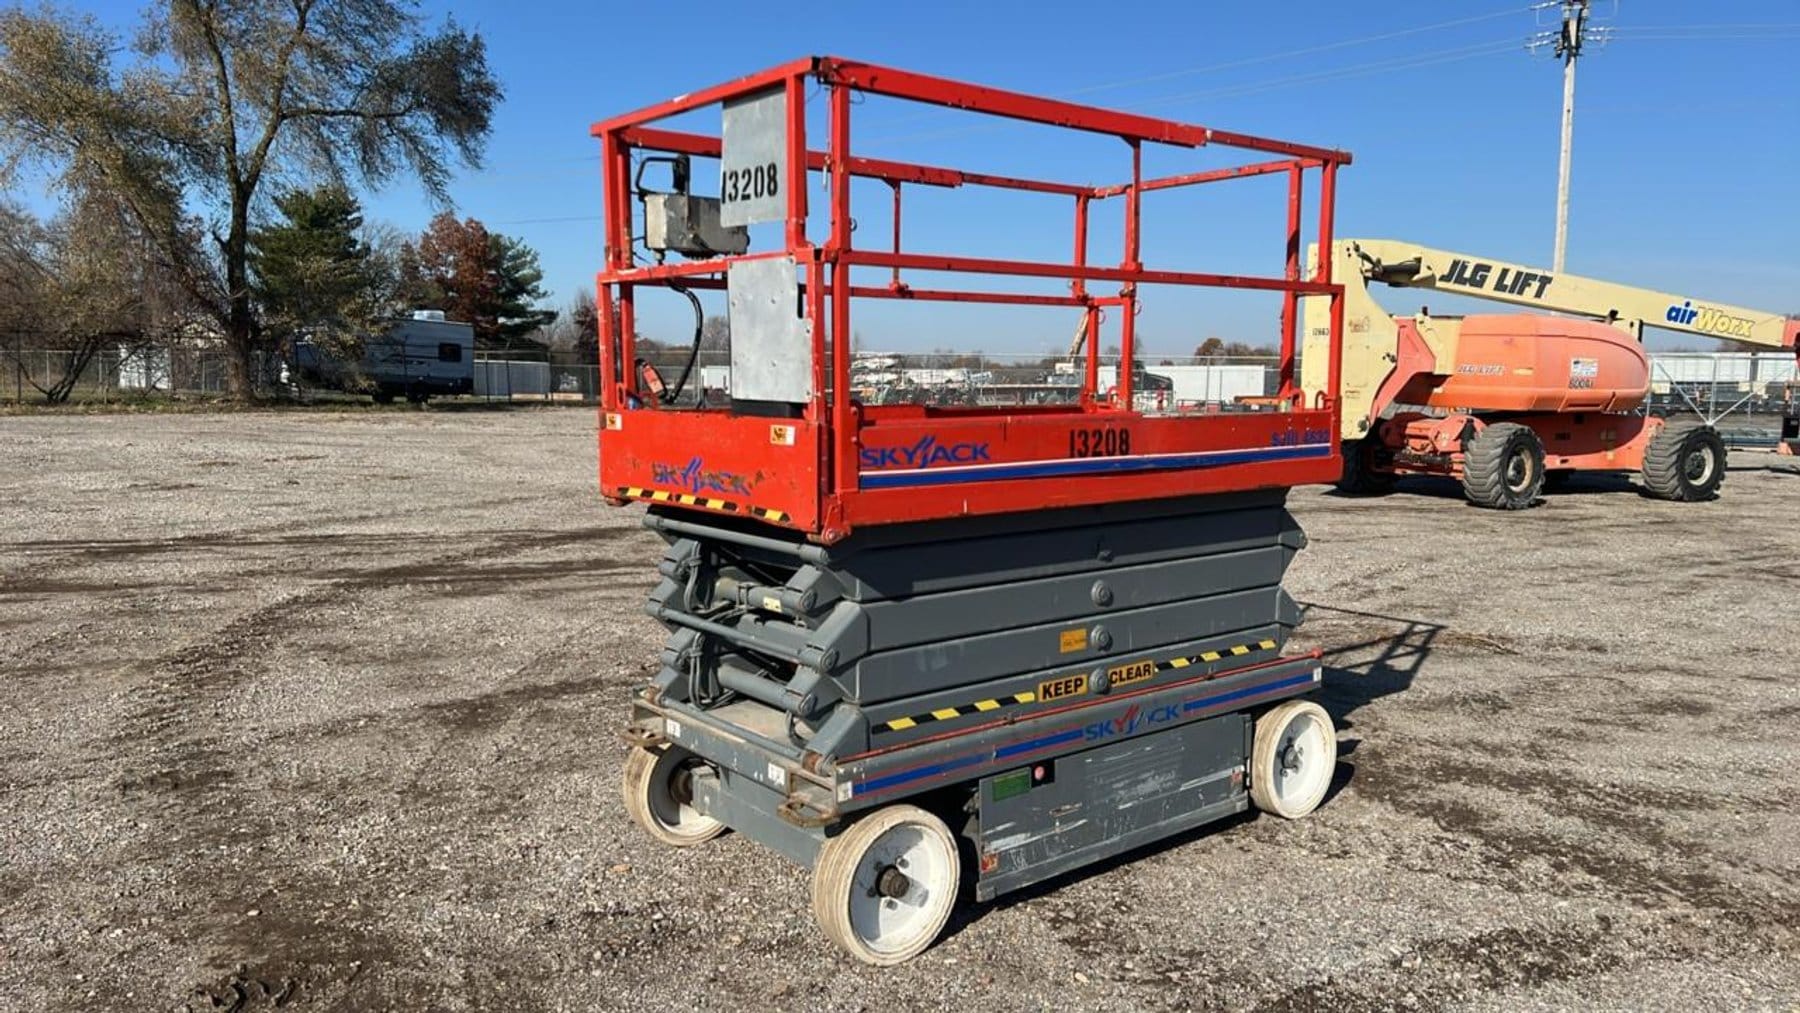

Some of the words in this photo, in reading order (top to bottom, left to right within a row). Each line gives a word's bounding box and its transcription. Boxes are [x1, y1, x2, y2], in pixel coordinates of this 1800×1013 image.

[721, 163, 778, 204] 13208
[1439, 259, 1492, 288] JLG
[1493, 267, 1554, 298] LIFT
[1666, 301, 1755, 337] airWorx
[861, 435, 989, 469] SKYJACK
[1069, 428, 1130, 458] 13208
[1042, 677, 1084, 700] KEEP
[1109, 663, 1152, 685] CLEAR
